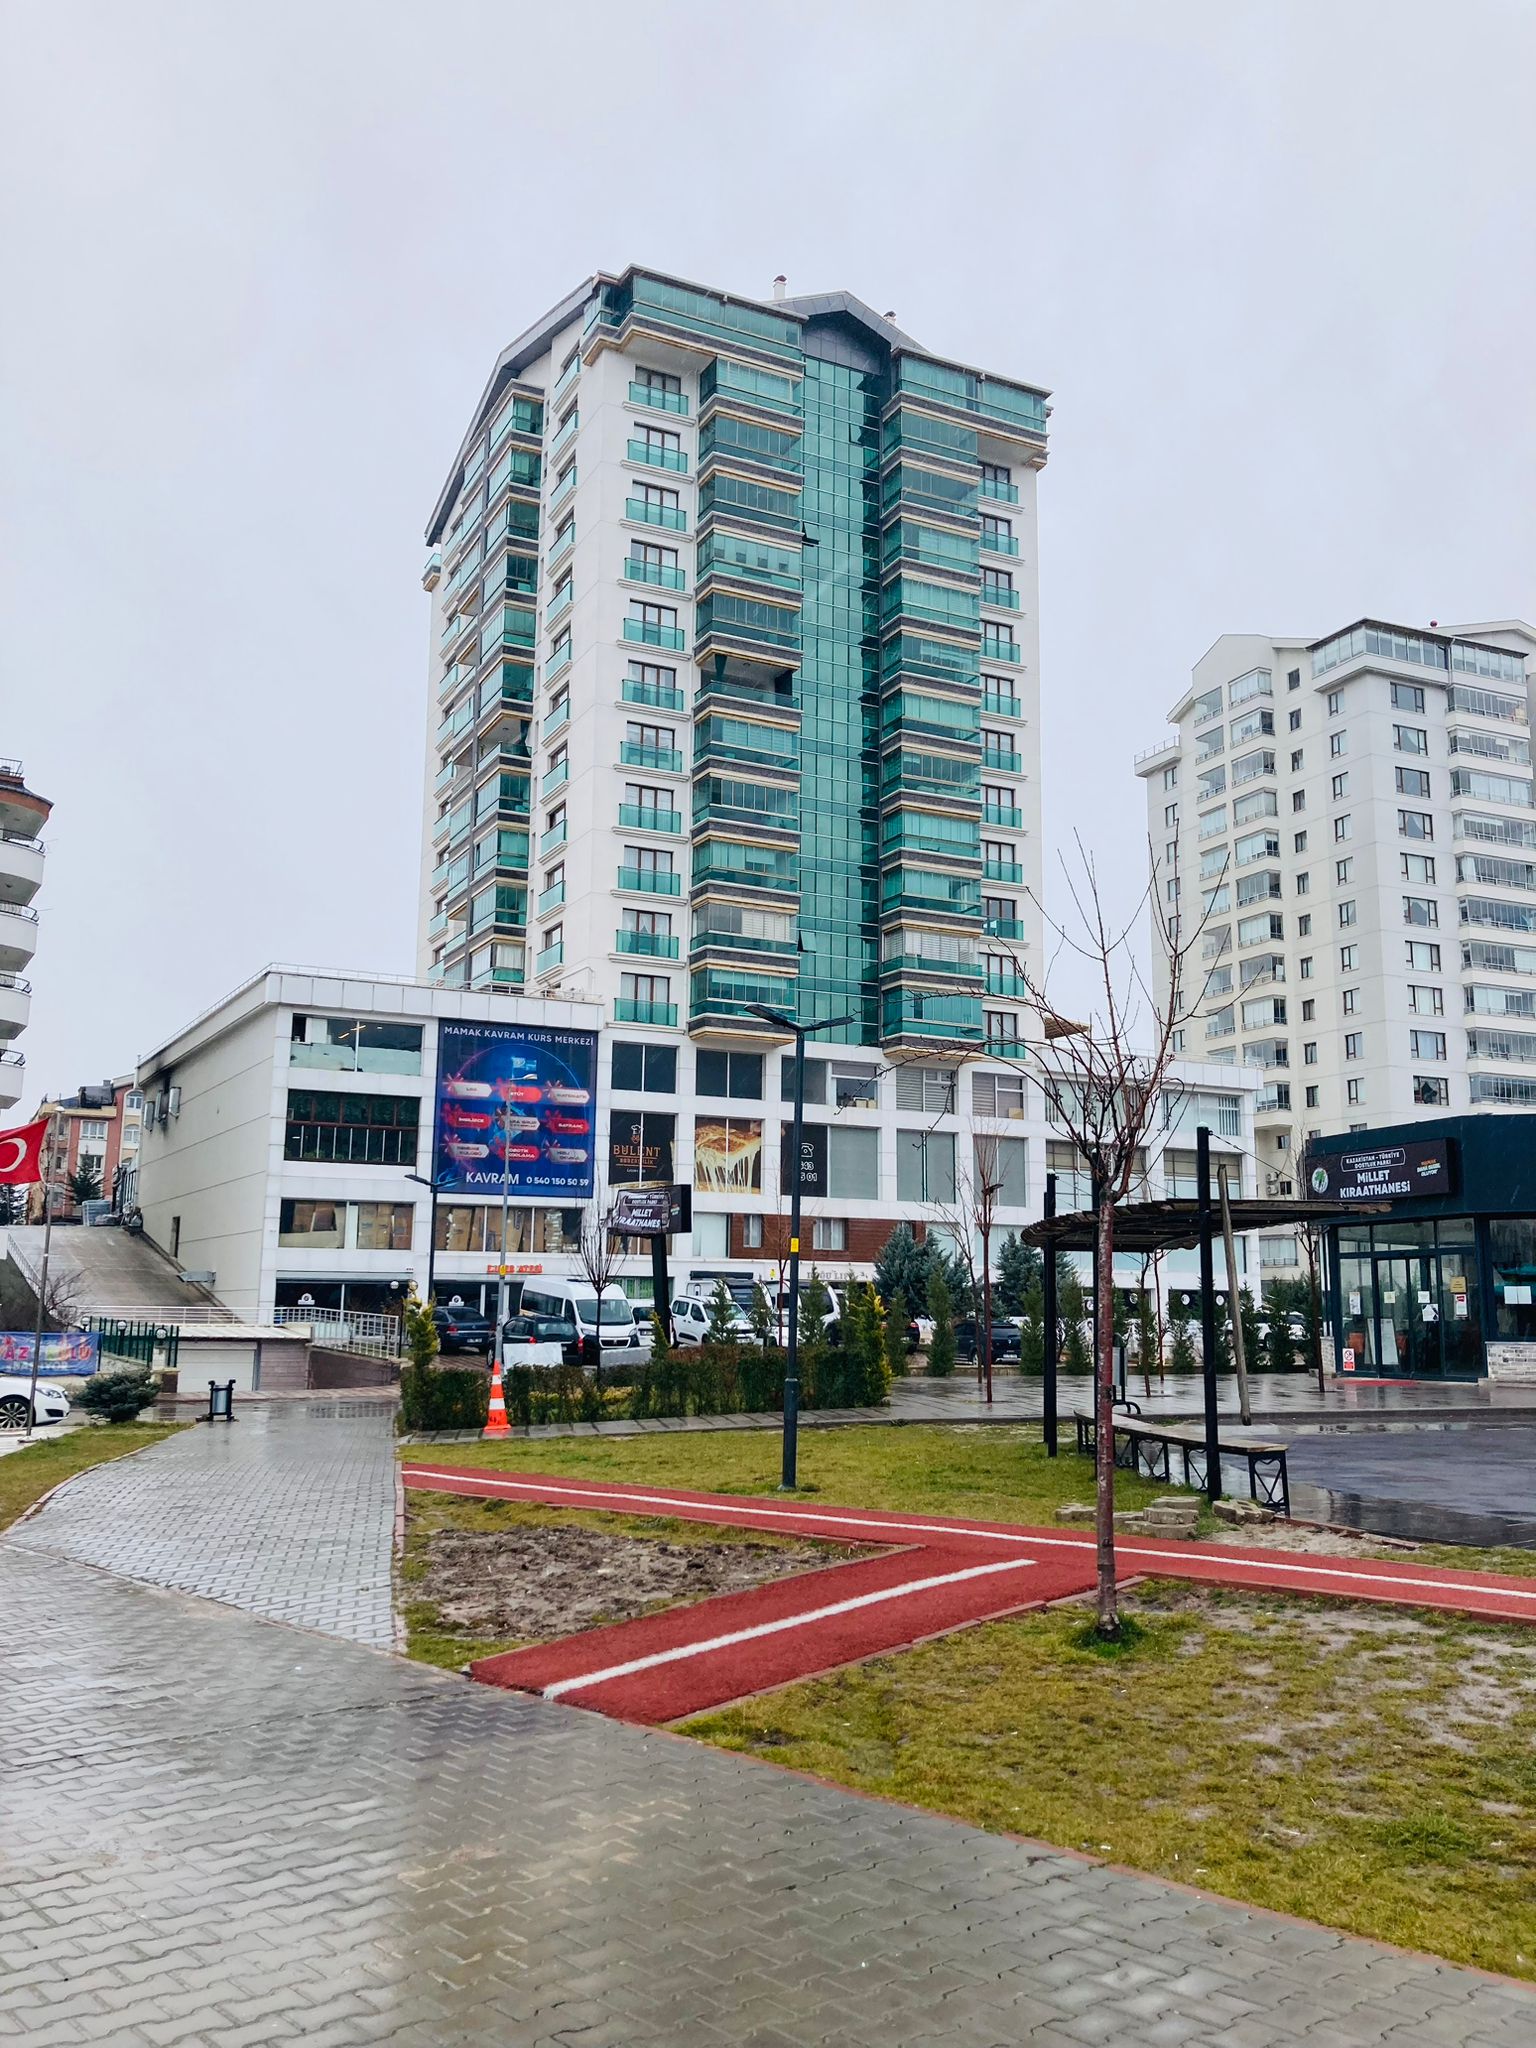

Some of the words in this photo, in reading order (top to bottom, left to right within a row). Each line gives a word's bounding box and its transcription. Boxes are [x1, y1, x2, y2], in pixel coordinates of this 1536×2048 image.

[444, 1026, 482, 1037] MAMAK
[484, 1030, 525, 1040] KAVRAM
[527, 1033, 552, 1043] KURS
[555, 1036, 594, 1046] MERKEZİ
[534, 1177, 550, 1185] 540
[551, 1177, 565, 1185] 150
[567, 1178, 578, 1186] 50
[1357, 1169, 1390, 1184] MİLLET
[1340, 1181, 1410, 1198] KIRAATHANESİ
